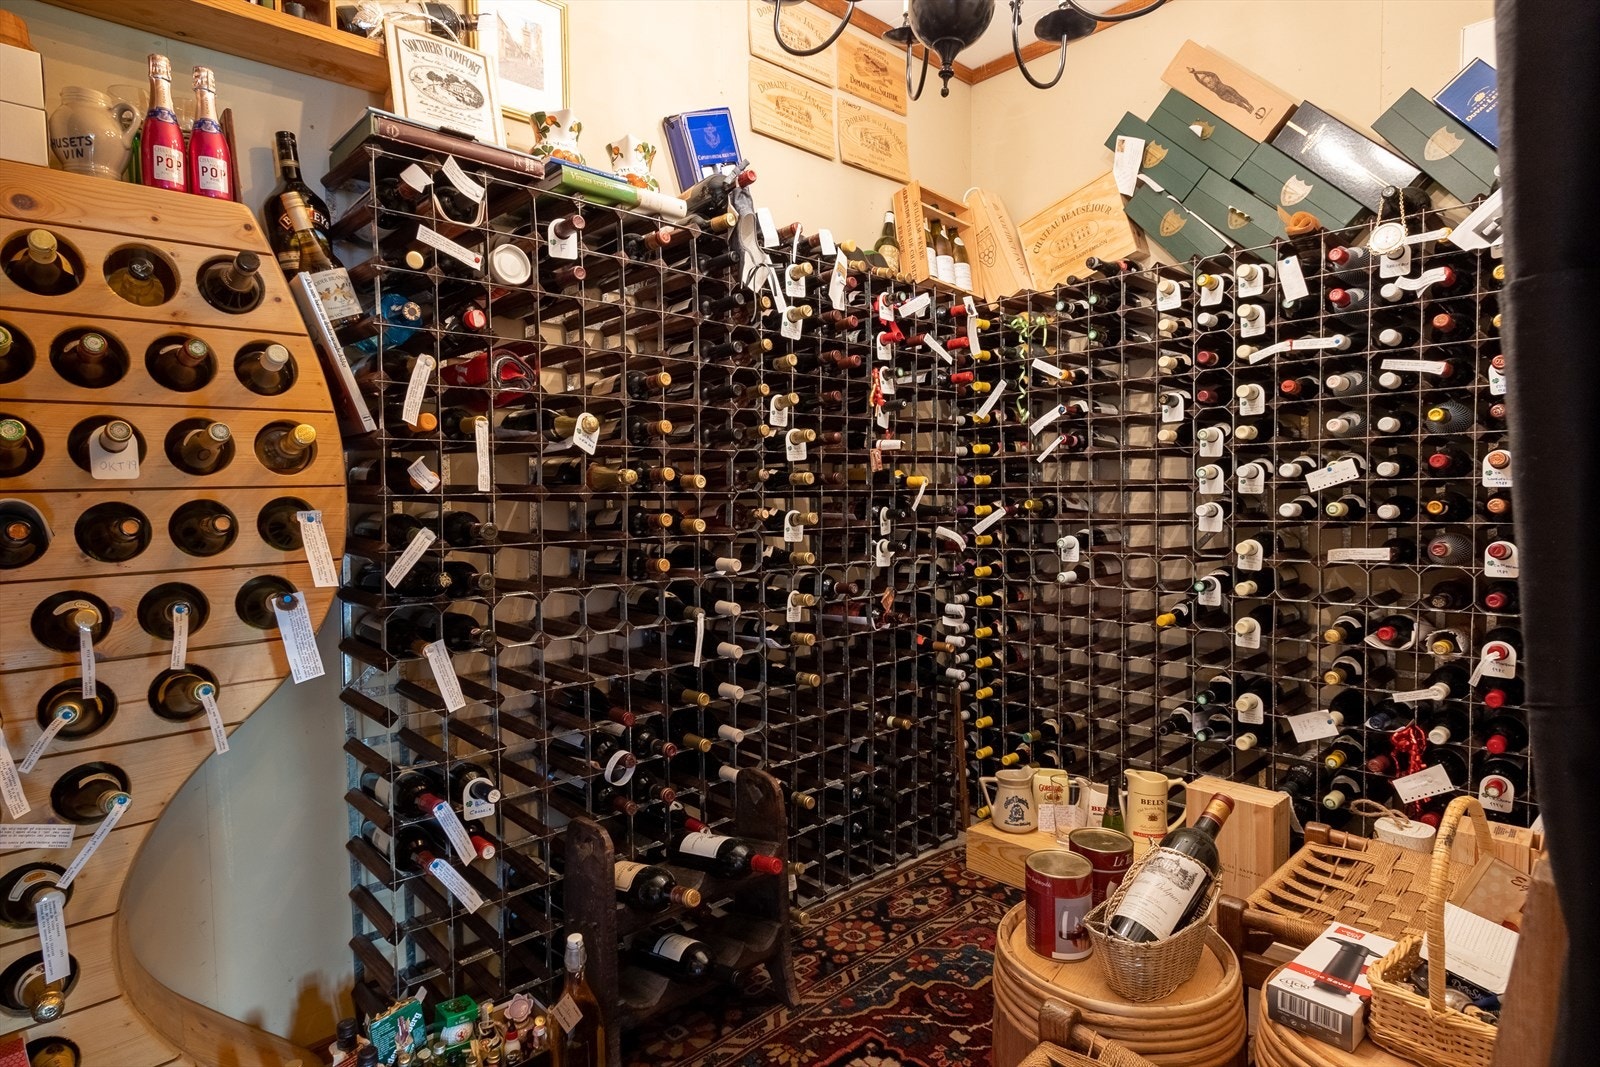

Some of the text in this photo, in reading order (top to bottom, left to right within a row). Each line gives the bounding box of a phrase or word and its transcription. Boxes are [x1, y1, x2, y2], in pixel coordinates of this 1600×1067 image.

[445, 47, 482, 75] COMFORT
[758, 81, 788, 94] DOMAINE
[51, 135, 93, 148] HUSETS
[63, 148, 84, 160] VIN
[157, 155, 182, 172] POP
[201, 165, 226, 178] POP
[284, 210, 330, 230] BEYS
[1033, 203, 1113, 254] CHATEAU BEAUSÉJOUR
[896, 225, 907, 254] FRANCE
[101, 461, 124, 471] OKT
[1305, 969, 1352, 990] Wine Saver
